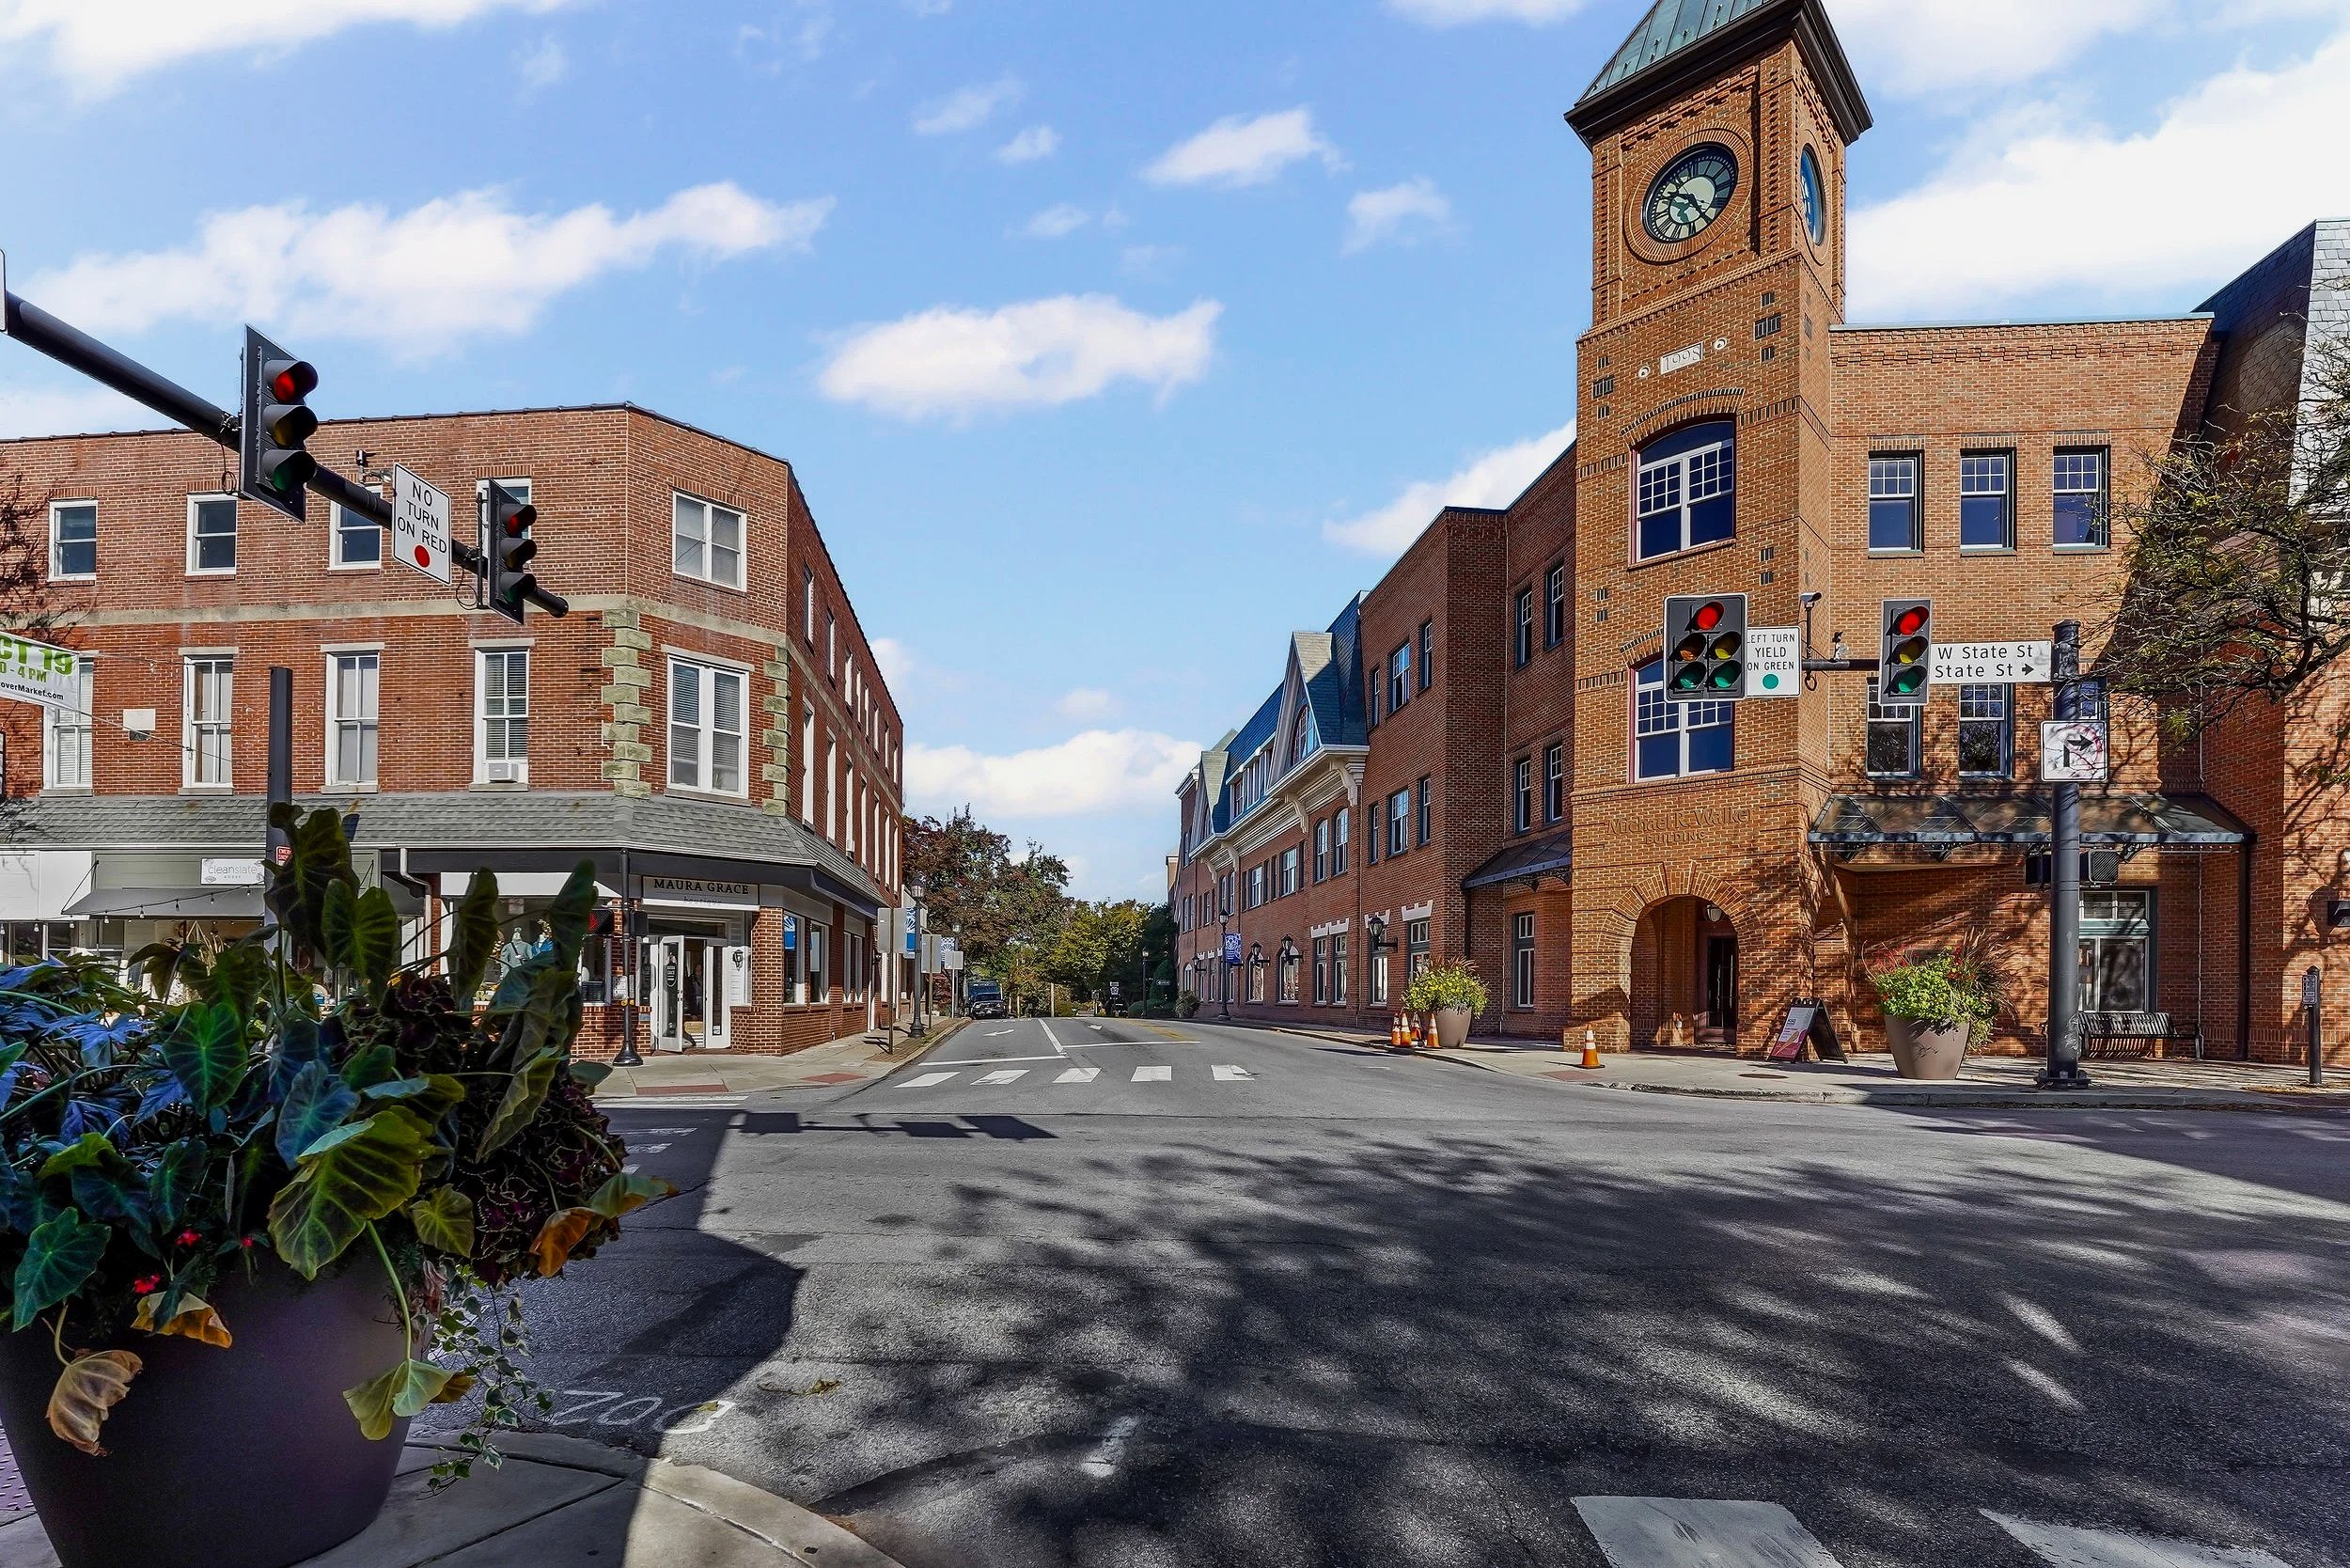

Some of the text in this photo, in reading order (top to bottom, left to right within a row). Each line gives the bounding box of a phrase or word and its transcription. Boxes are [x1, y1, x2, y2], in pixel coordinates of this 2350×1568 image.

[1665, 346, 1700, 371] 1998
[413, 480, 432, 507] NO
[406, 499, 439, 531] TURN
[398, 517, 447, 554] ON RED
[1772, 634, 1795, 643] TURN
[1754, 647, 1787, 658] YIELD
[1937, 644, 2033, 660] W State St
[39, 648, 72, 675] 19
[1747, 661, 1794, 671] ON GREEN
[18, 666, 24, 678] 4
[28, 667, 47, 682] PM
[1935, 663, 2013, 678] State St
[0, 682, 64, 700] overMarket.com
[1606, 813, 1669, 836] Michael
[1693, 807, 1755, 828] Walker
[1645, 830, 1707, 845] BUILDING
[653, 878, 749, 895] MAURA GRACE
